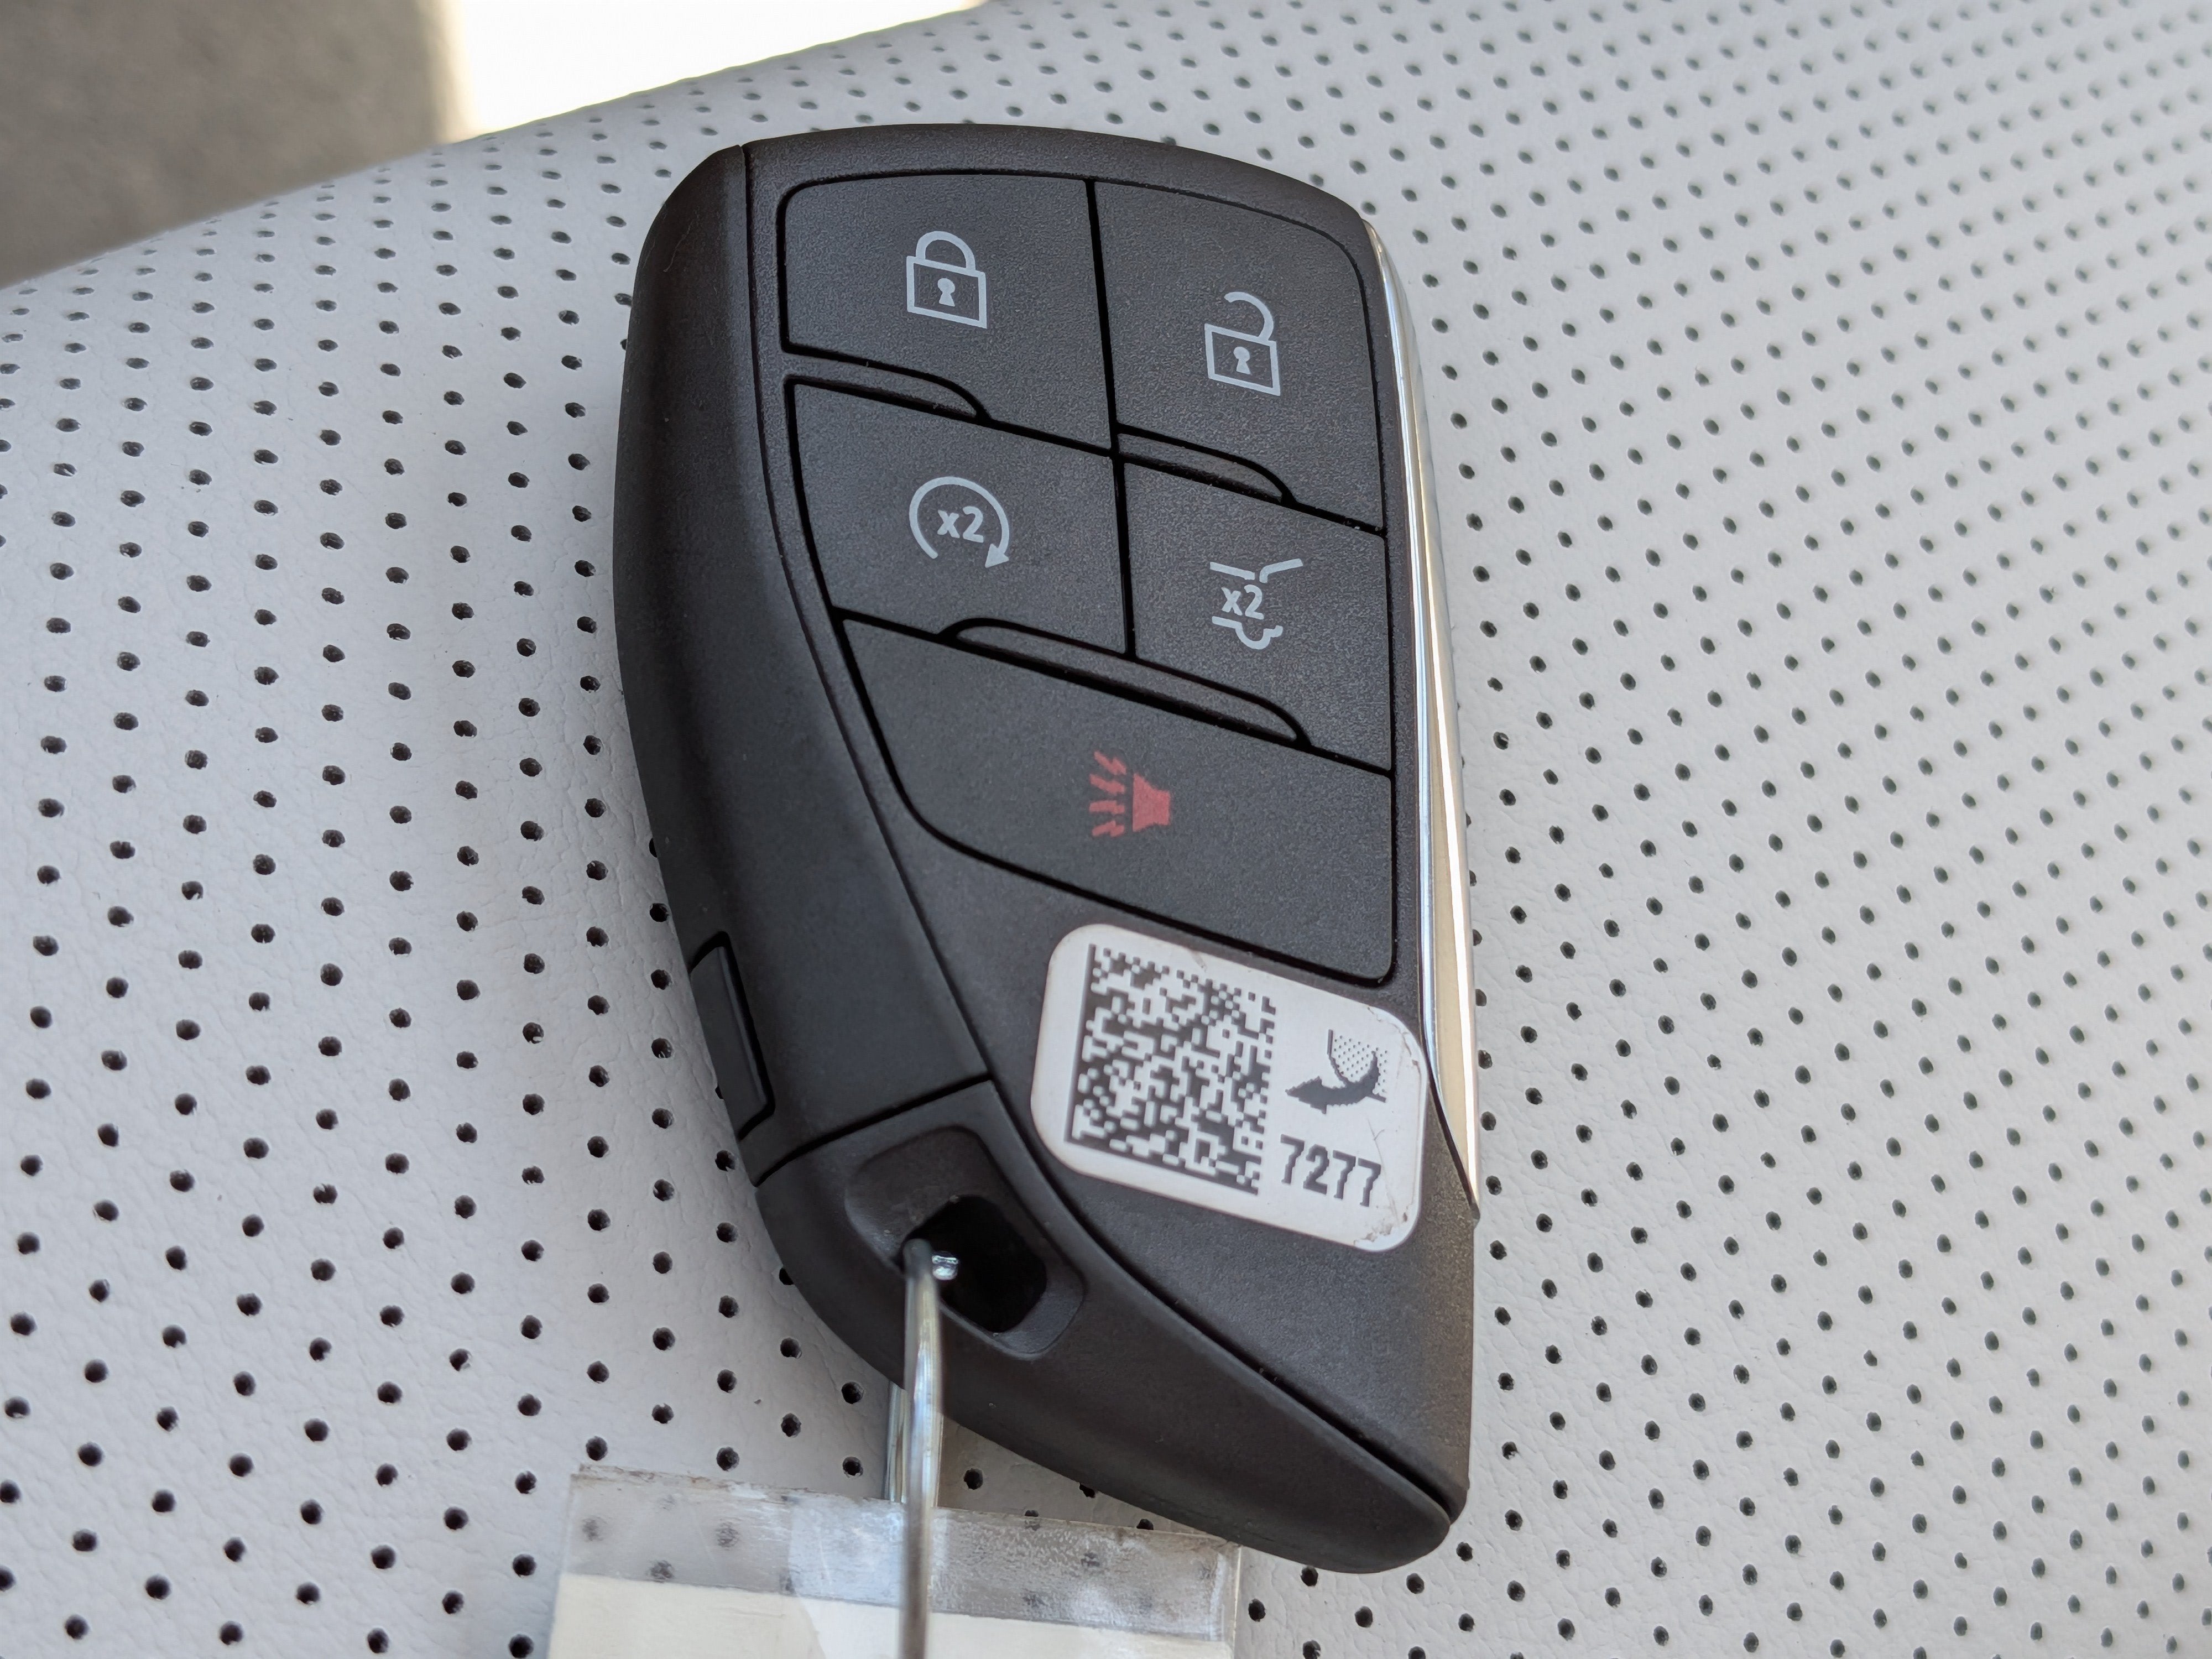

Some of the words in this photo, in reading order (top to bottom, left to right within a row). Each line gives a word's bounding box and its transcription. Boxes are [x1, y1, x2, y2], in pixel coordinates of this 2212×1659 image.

[937, 506, 984, 543] x2
[1221, 584, 1264, 620] x2
[1280, 1134, 1382, 1207] 7277
